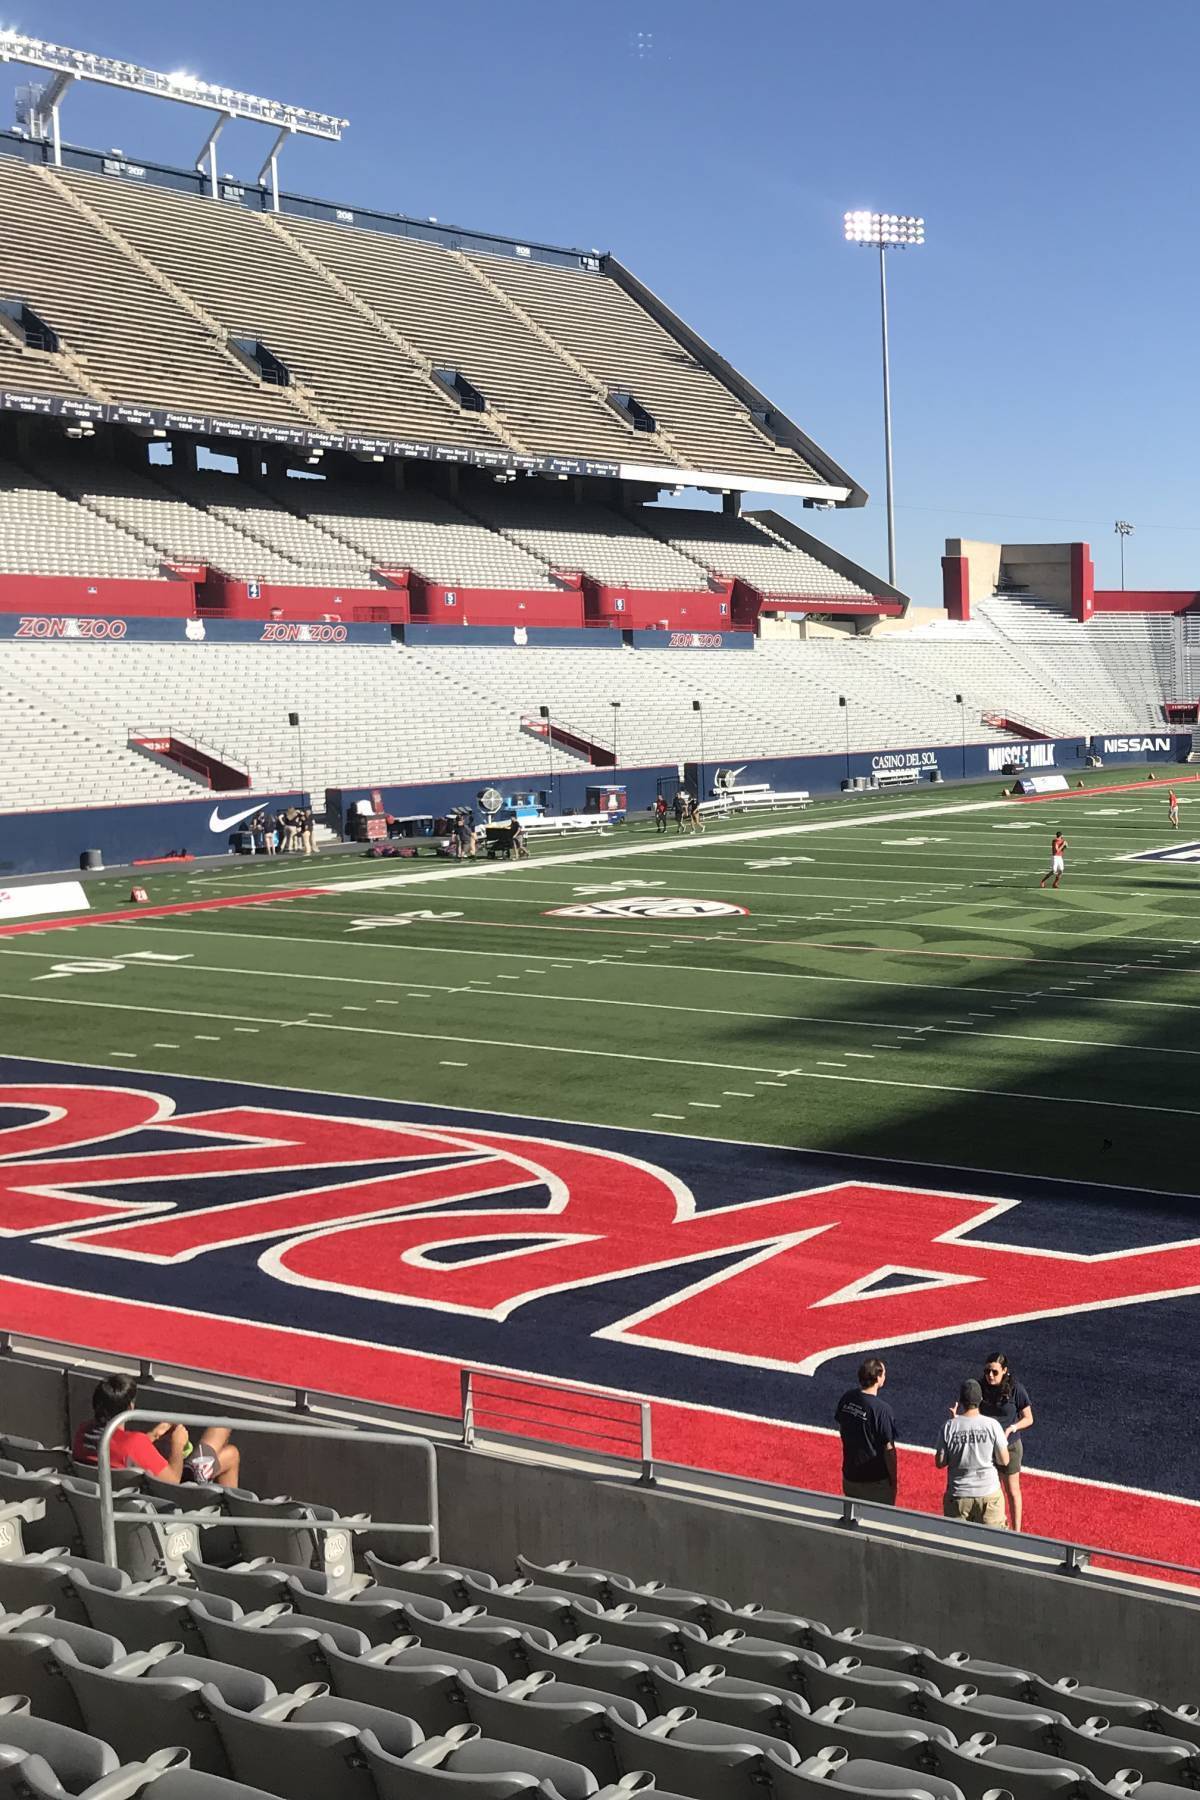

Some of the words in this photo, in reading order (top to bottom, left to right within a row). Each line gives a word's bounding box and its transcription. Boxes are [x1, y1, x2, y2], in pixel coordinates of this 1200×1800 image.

[5, 393, 31, 403] Copper
[32, 397, 51, 405] Bowl
[84, 403, 102, 411] Bowl
[118, 407, 132, 416] Sun
[133, 410, 151, 418] Bowl
[166, 414, 187, 422] Fiesta
[187, 416, 204, 424] Bowl
[241, 422, 257, 431] Bowl
[289, 429, 303, 437] Bowl
[329, 435, 345, 443] Bowl
[1104, 738, 1171, 753] NISSAN
[872, 754, 904, 769] CASINO
[906, 753, 922, 766] DEL
[922, 752, 937, 765] SOL
[989, 747, 1028, 771] MUSCLE
[1030, 744, 1056, 768] MILK
